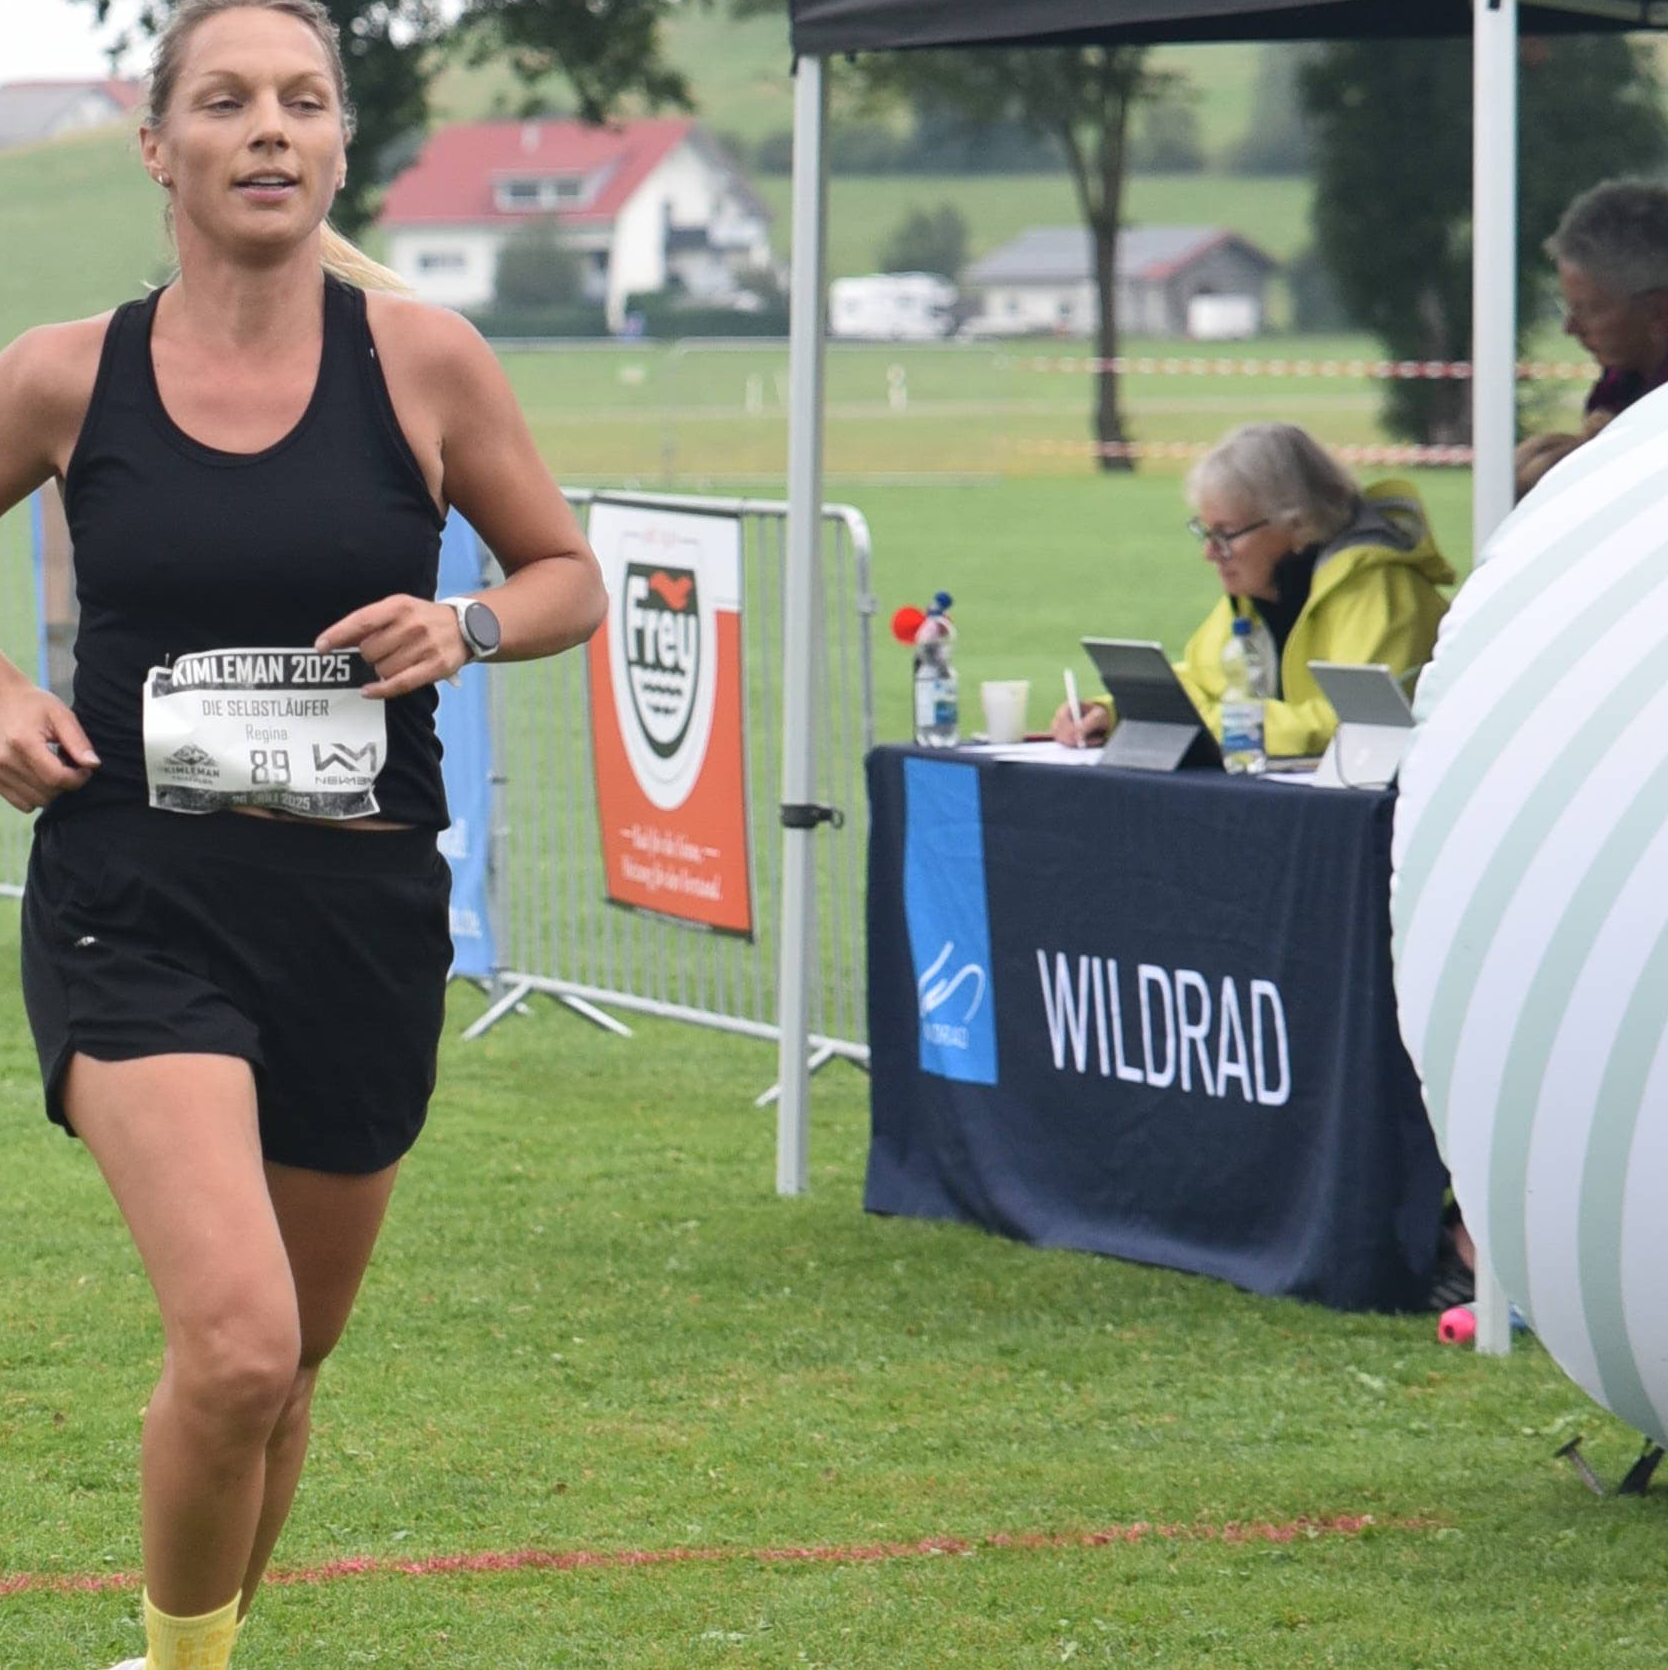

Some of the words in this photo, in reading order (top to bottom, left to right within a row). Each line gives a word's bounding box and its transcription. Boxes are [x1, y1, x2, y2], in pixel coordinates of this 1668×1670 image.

[173, 655, 284, 687] KIMLEMAN
[291, 655, 350, 683] 2025
[202, 699, 223, 716] DIE
[227, 697, 329, 716] SELBSTLÄUFER
[245, 724, 288, 743] Regina
[250, 750, 291, 785] 89
[1037, 949, 1291, 1106] WILDRAD
